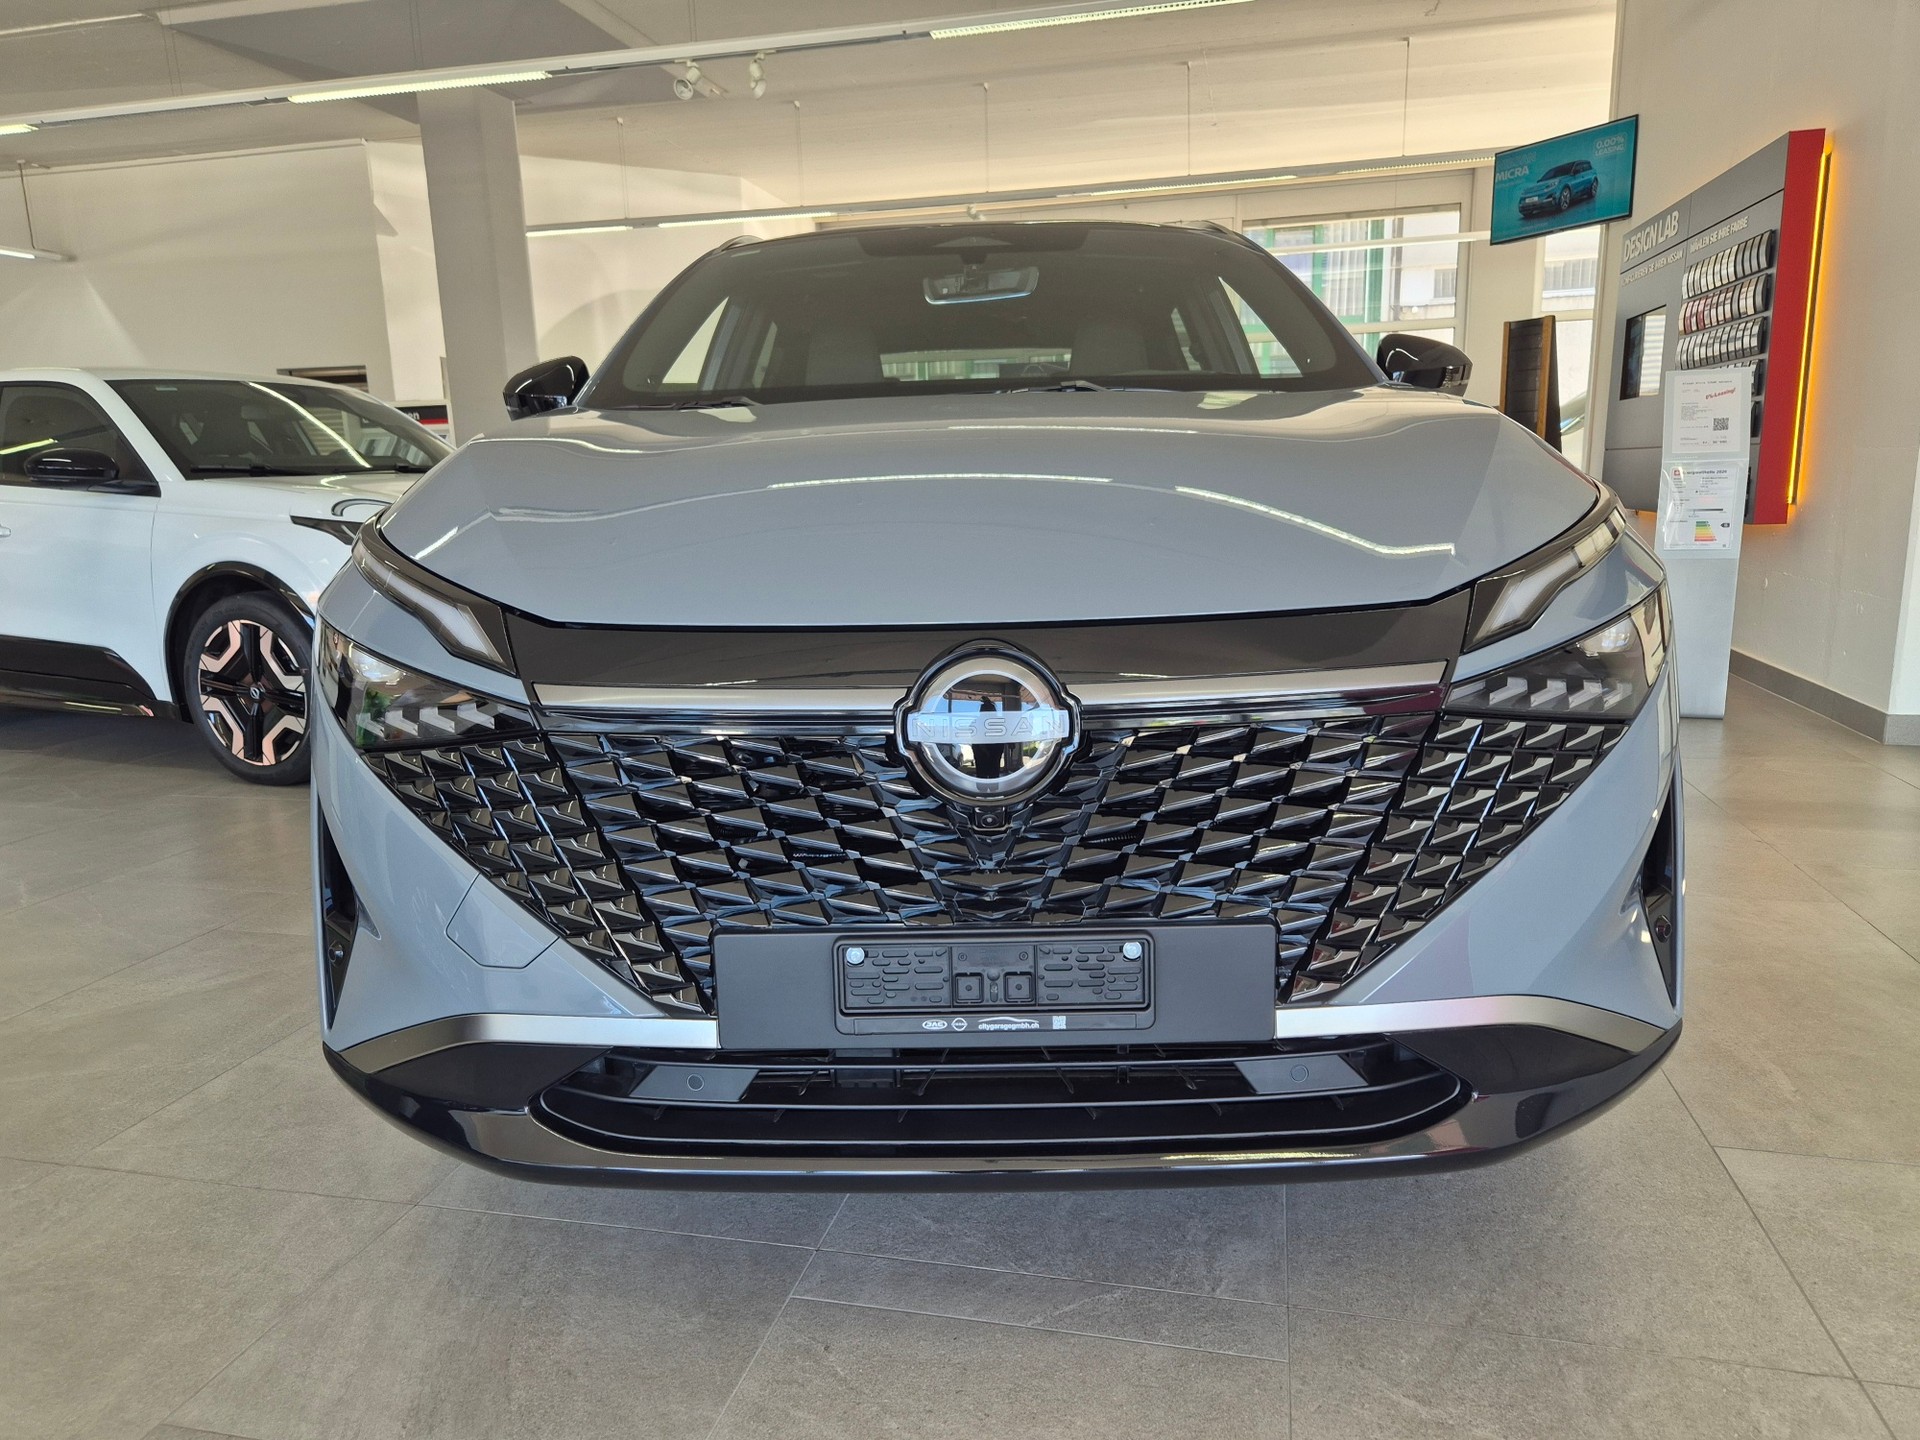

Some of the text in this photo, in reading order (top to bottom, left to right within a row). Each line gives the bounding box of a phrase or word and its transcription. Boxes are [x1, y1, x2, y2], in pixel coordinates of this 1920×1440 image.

[1596, 136, 1624, 149] 0.00%
[1496, 166, 1529, 181] MICRA
[1624, 211, 1679, 262] DESIGN LAB
[911, 714, 1066, 738] NISSAN
